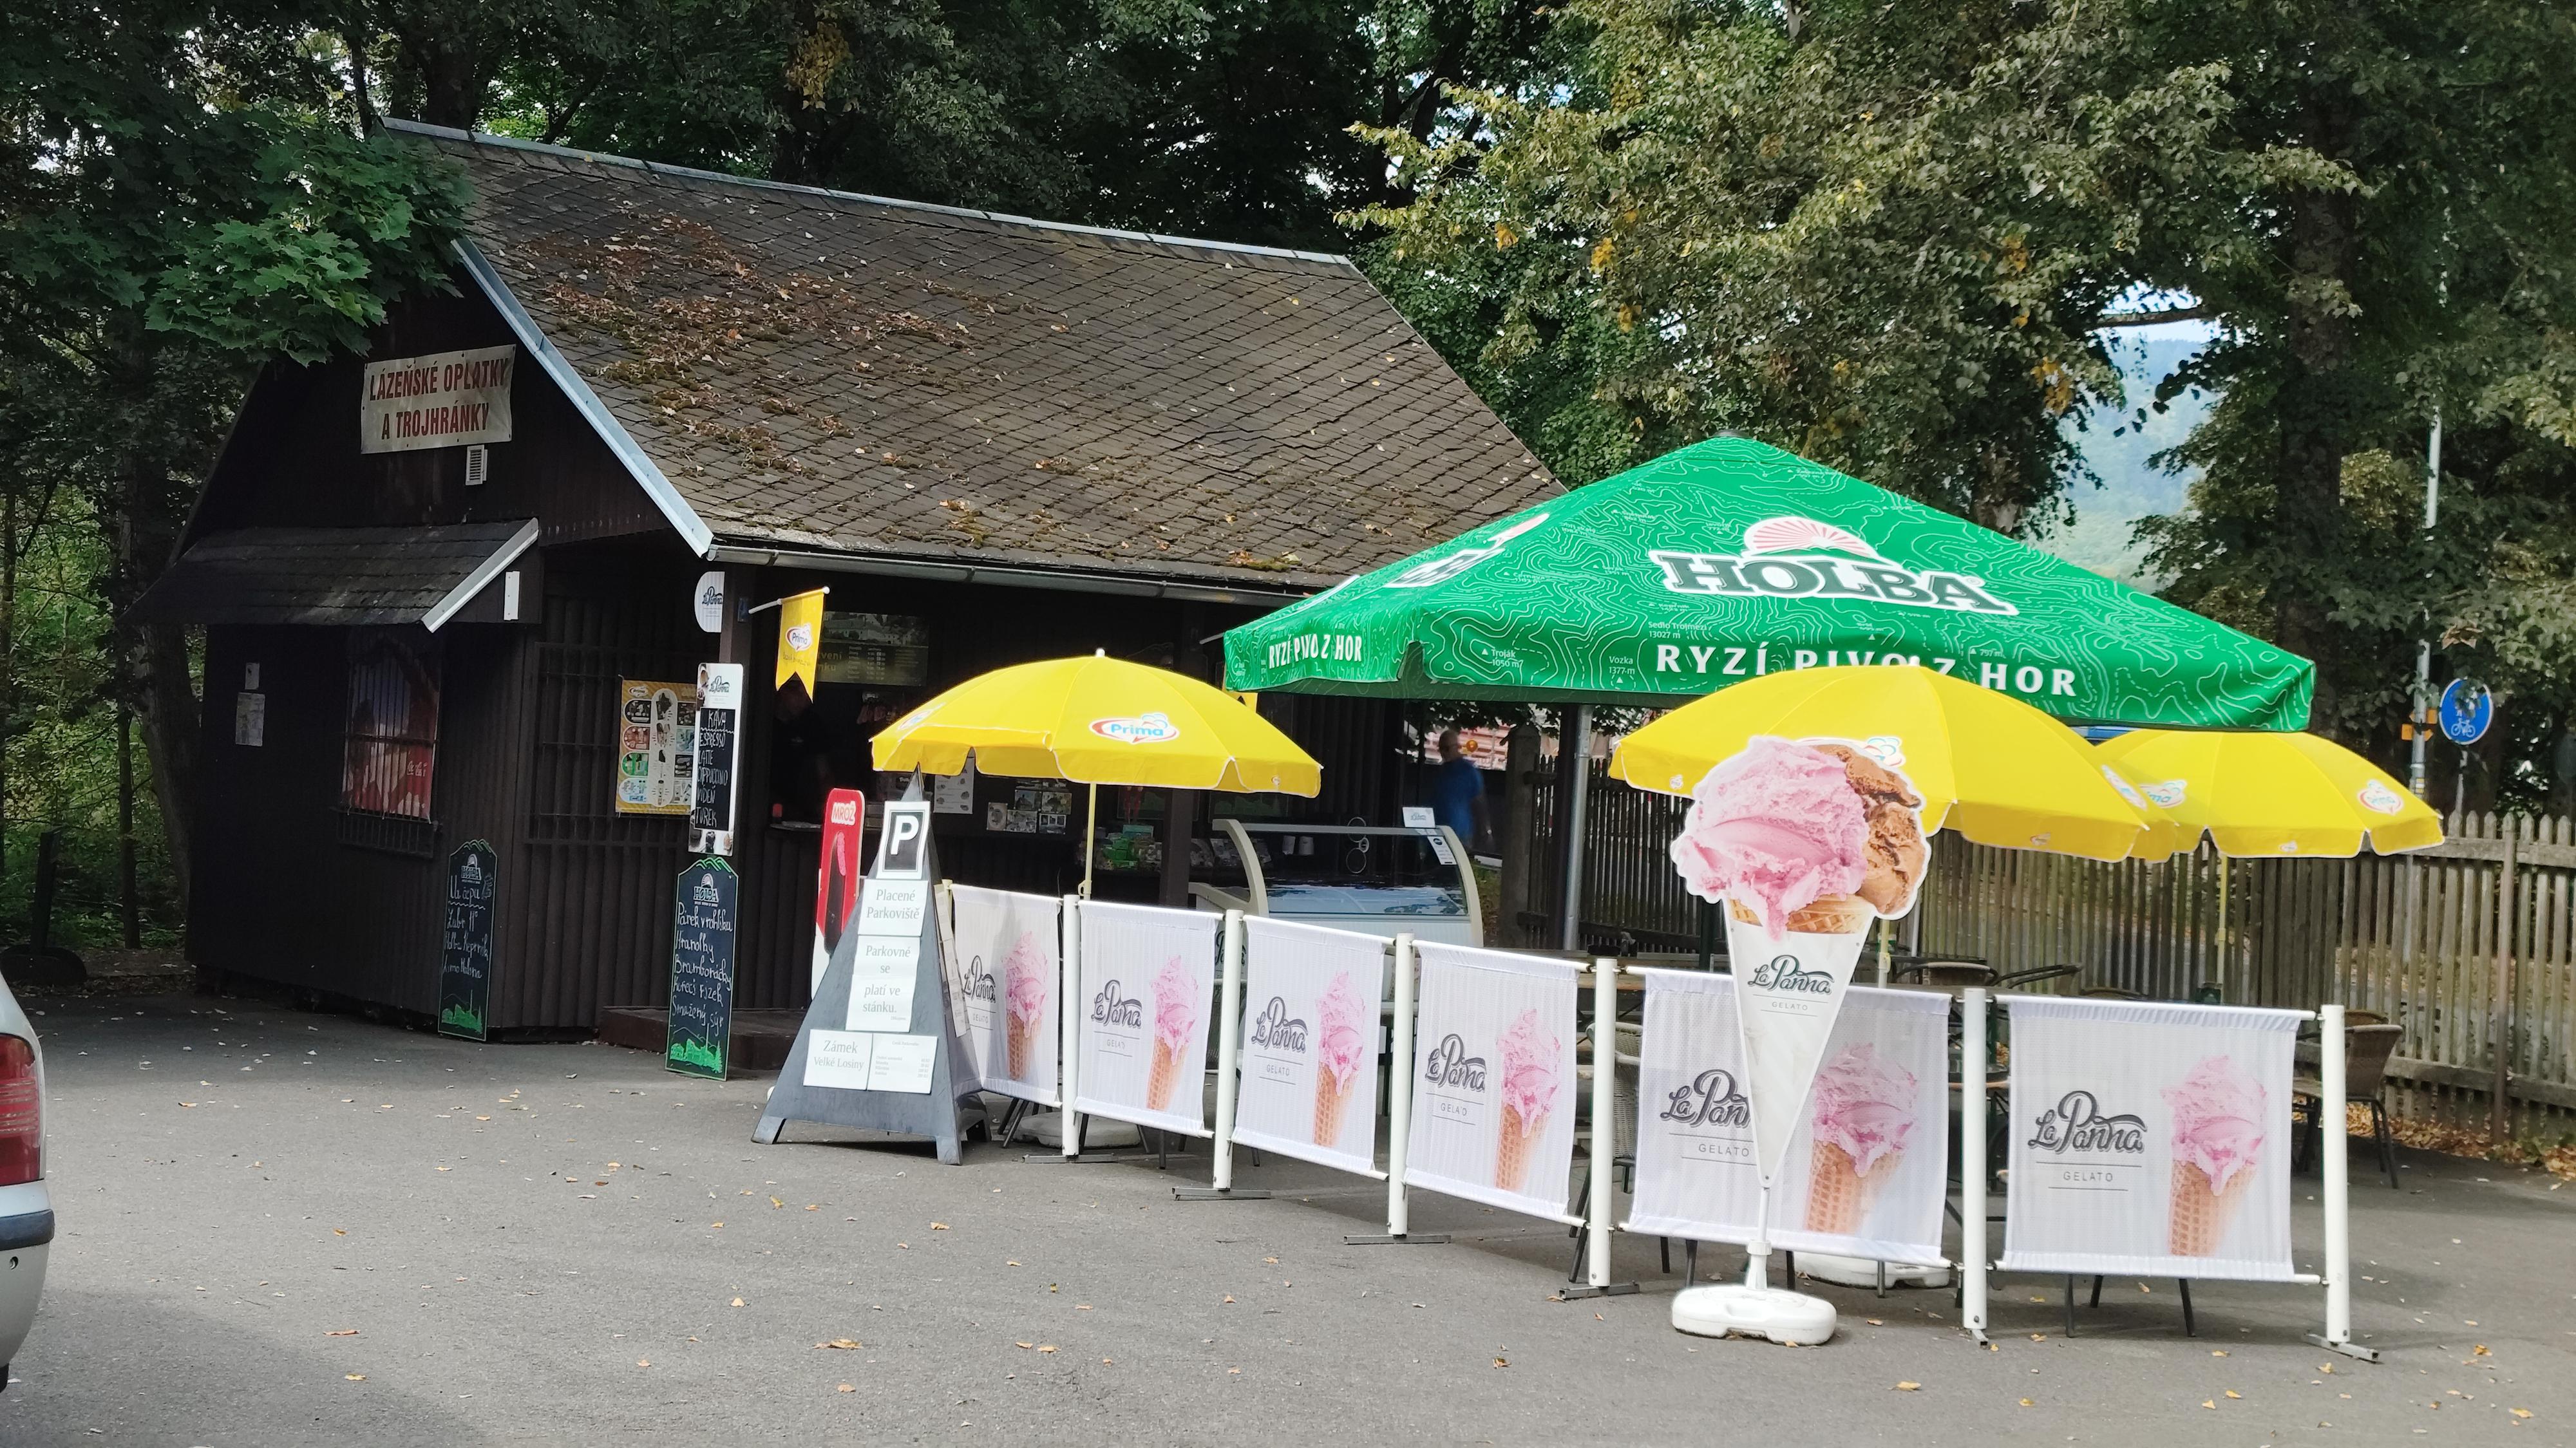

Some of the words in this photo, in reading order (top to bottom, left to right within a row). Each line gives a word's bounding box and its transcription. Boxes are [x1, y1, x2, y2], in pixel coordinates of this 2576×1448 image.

[369, 361, 439, 401] LÁZEŇSKÉ
[443, 357, 509, 391] OPLATKY
[381, 413, 390, 440] A
[395, 400, 489, 438] TROJHRÁNKY
[1655, 554, 2014, 614] HOLBA
[1648, 621, 1671, 630] Sedlo
[791, 632, 808, 645] Prima
[1269, 634, 1292, 669] RYZÍ
[1294, 634, 1319, 661] PIVO
[1321, 634, 1331, 659] Z
[1334, 634, 1362, 662] HOR
[1491, 649, 1516, 659] Troják
[1492, 659, 1510, 667] 1050
[1609, 656, 1633, 665] Vozka
[1656, 641, 1770, 676] RYZÍ
[1980, 662, 2077, 697] HOR
[708, 708, 726, 729] KÁVA
[1111, 723, 1164, 737] Prima
[699, 731, 726, 748] ESPRESSO
[833, 802, 855, 822] MROŽ
[891, 815, 920, 856] P
[876, 889, 916, 902] Placené
[677, 901, 700, 928] Párek
[866, 906, 920, 920] Parkoviště
[675, 930, 715, 964] Hranolky
[866, 945, 911, 958] Parkovné
[880, 964, 891, 973] se
[1747, 964, 1772, 987] La
[1767, 954, 1835, 995] Panna
[963, 967, 972, 997] La
[971, 955, 996, 1004] Panna
[864, 983, 887, 998] platí
[889, 987, 901, 996] ve
[863, 1001, 897, 1013] stánku.
[1091, 992, 1106, 1023] La
[1104, 979, 1142, 1029] Panna
[1772, 1001, 1809, 1011] GELATO
[1251, 1010, 1267, 1048] La
[1265, 996, 1309, 1053] Panna
[823, 1039, 858, 1054] Zámek
[814, 1056, 835, 1067] Velké
[837, 1057, 865, 1071] Losiny
[1266, 1063, 1291, 1077] GELATO
[1425, 1046, 1442, 1084] La
[1440, 1033, 1488, 1093] Panna
[1660, 1084, 1695, 1123] La
[1690, 1068, 1752, 1129] Pan
[1440, 1102, 1468, 1116] GELAO
[2027, 1109, 2060, 1150] La
[2056, 1089, 2148, 1155] Panna
[1698, 1143, 1750, 1158] GELATO
[2062, 1171, 2114, 1183] GELATO
